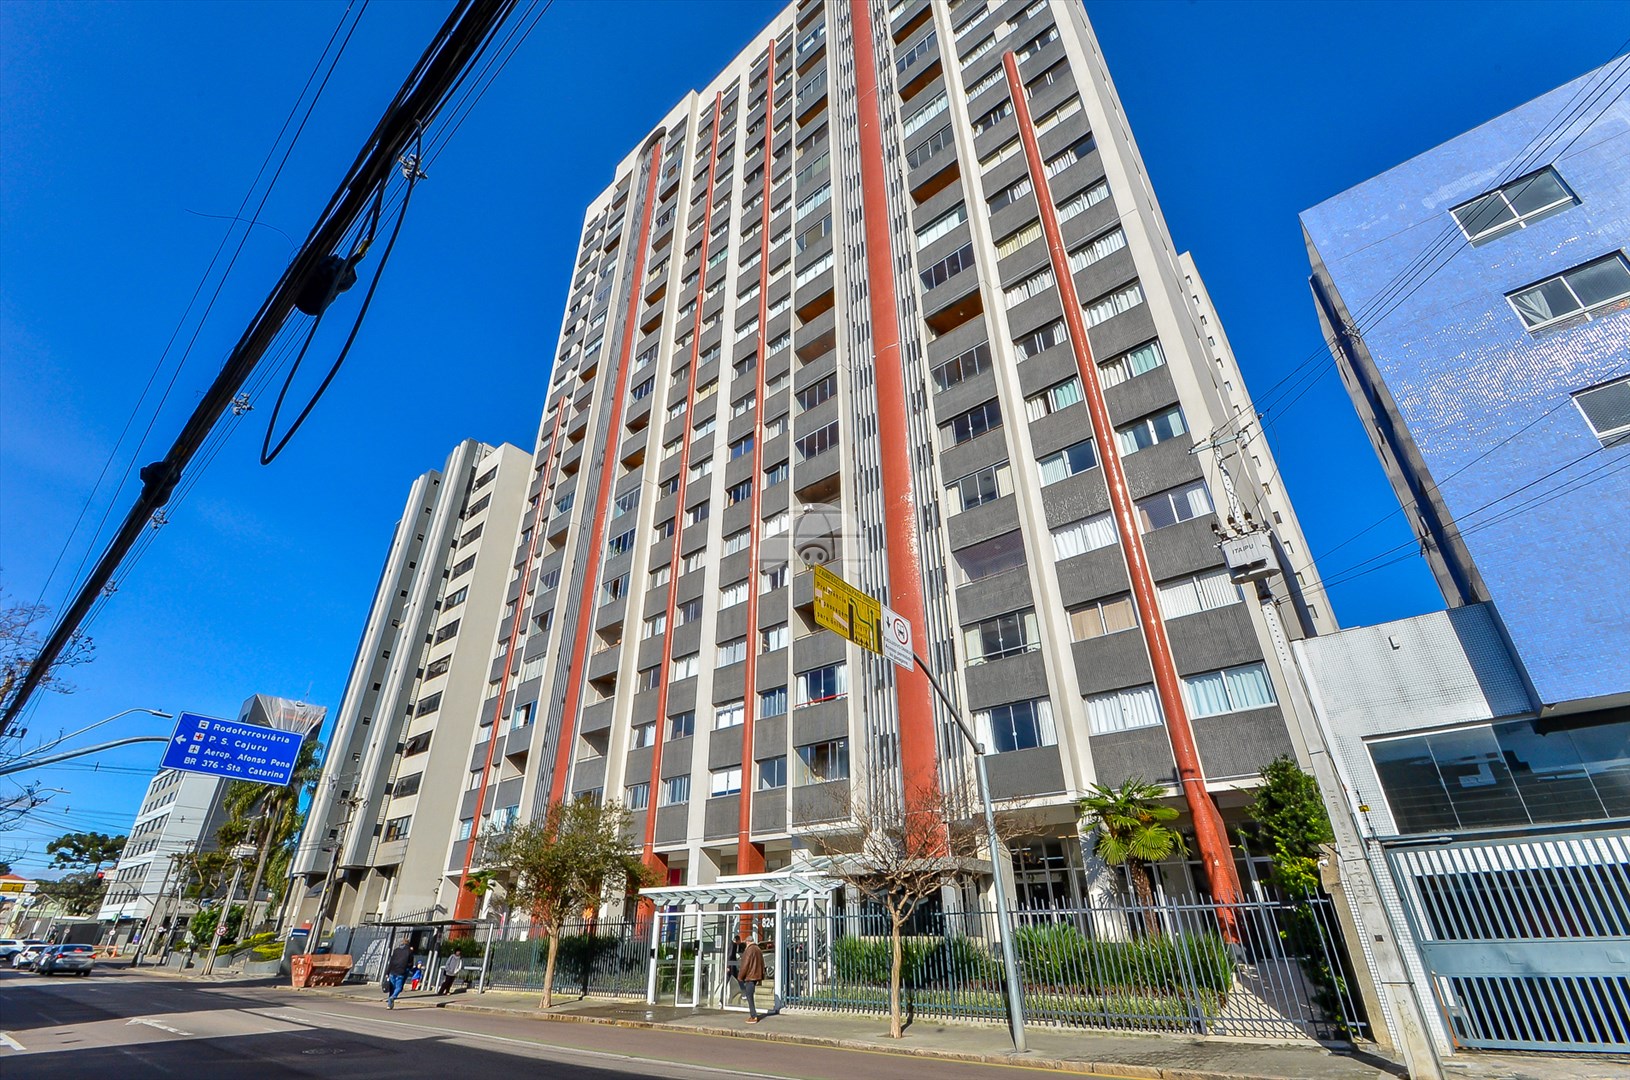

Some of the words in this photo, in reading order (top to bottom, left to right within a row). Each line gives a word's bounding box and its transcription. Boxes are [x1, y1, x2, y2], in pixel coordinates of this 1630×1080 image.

[1232, 543, 1254, 555] ITAIPU
[213, 723, 290, 744] Rodoferroviária
[208, 735, 217, 744] P.
[220, 738, 229, 746] S.
[234, 740, 268, 752] Cajuru
[183, 756, 197, 765] BR
[201, 760, 219, 769] 376
[226, 763, 243, 773] Sta.
[248, 767, 284, 779] Catarina
[204, 748, 232, 760] Aerop.
[237, 753, 267, 765] Afonso
[270, 759, 291, 769] Pena
[761, 917, 775, 928] 824
